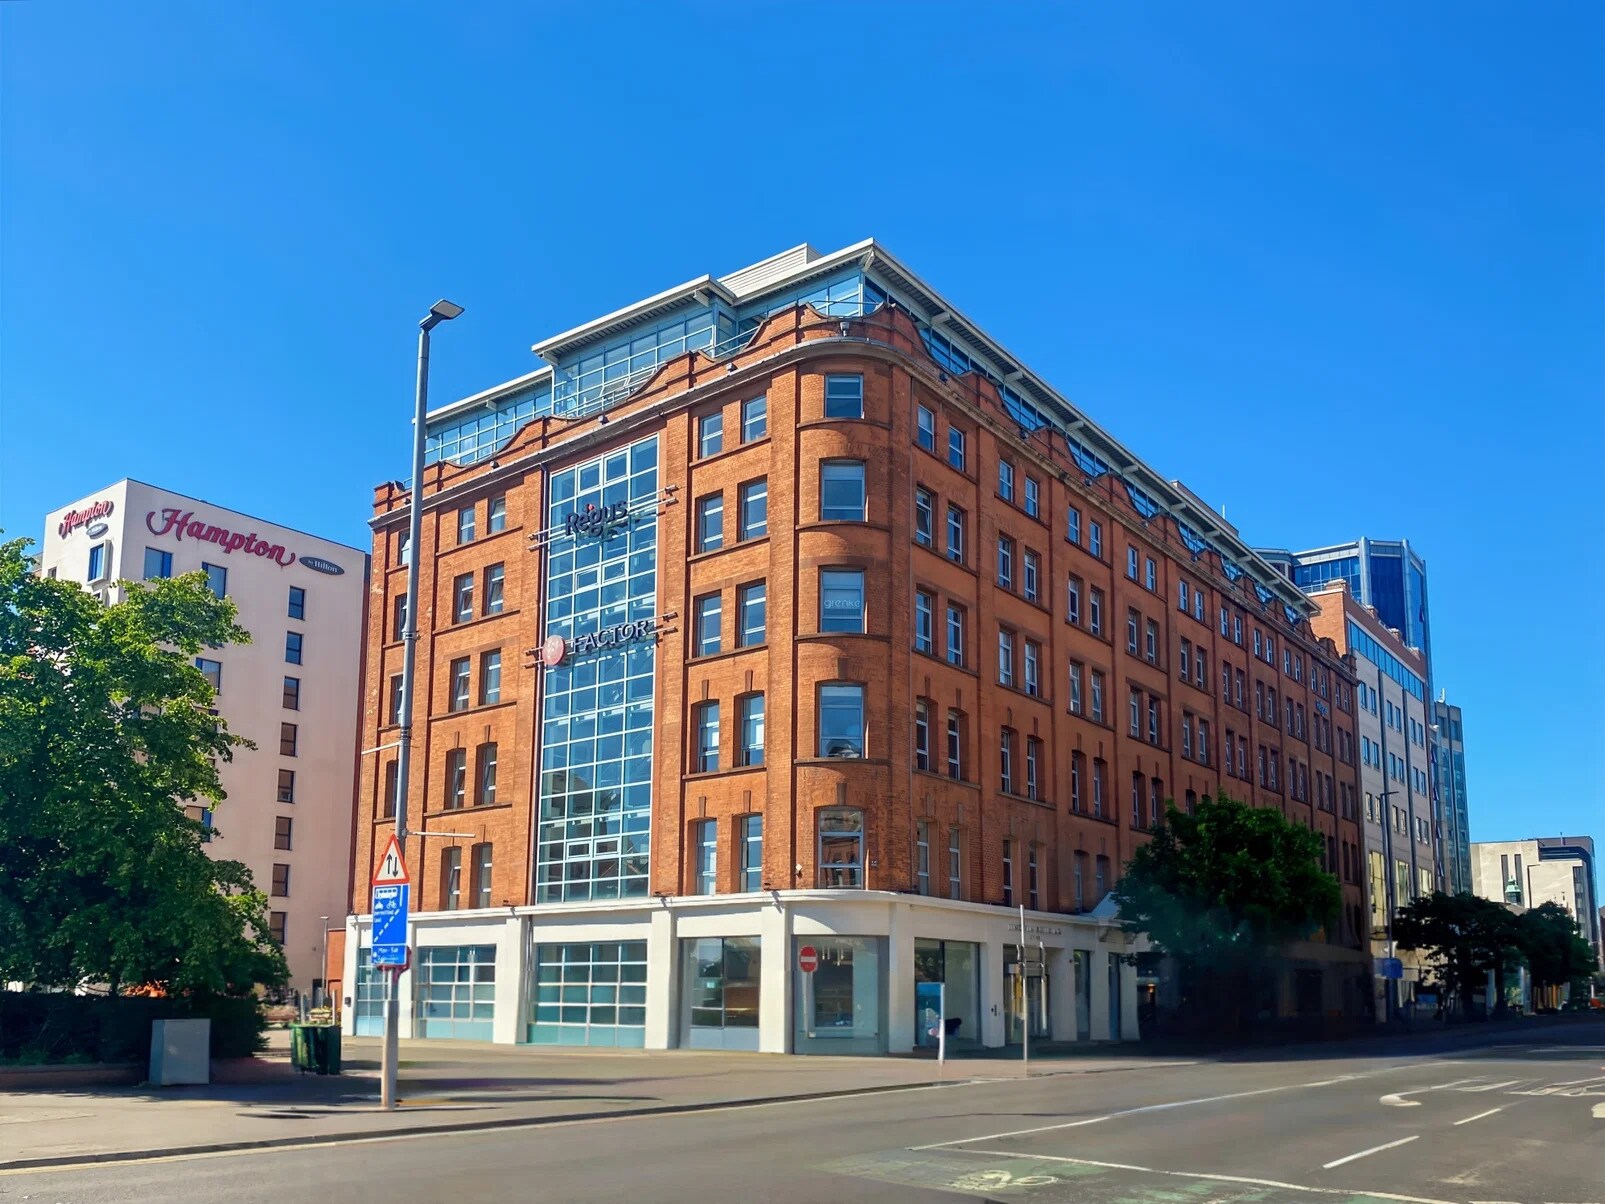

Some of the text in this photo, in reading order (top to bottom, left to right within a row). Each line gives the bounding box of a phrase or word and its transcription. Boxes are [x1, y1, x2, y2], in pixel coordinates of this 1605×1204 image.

[59, 500, 112, 539] Hampton
[565, 500, 628, 537] Regus
[146, 508, 296, 567] Hampton
[314, 560, 338, 573] Hilton
[823, 599, 860, 608] grenke
[573, 619, 649, 654] FACTOR
